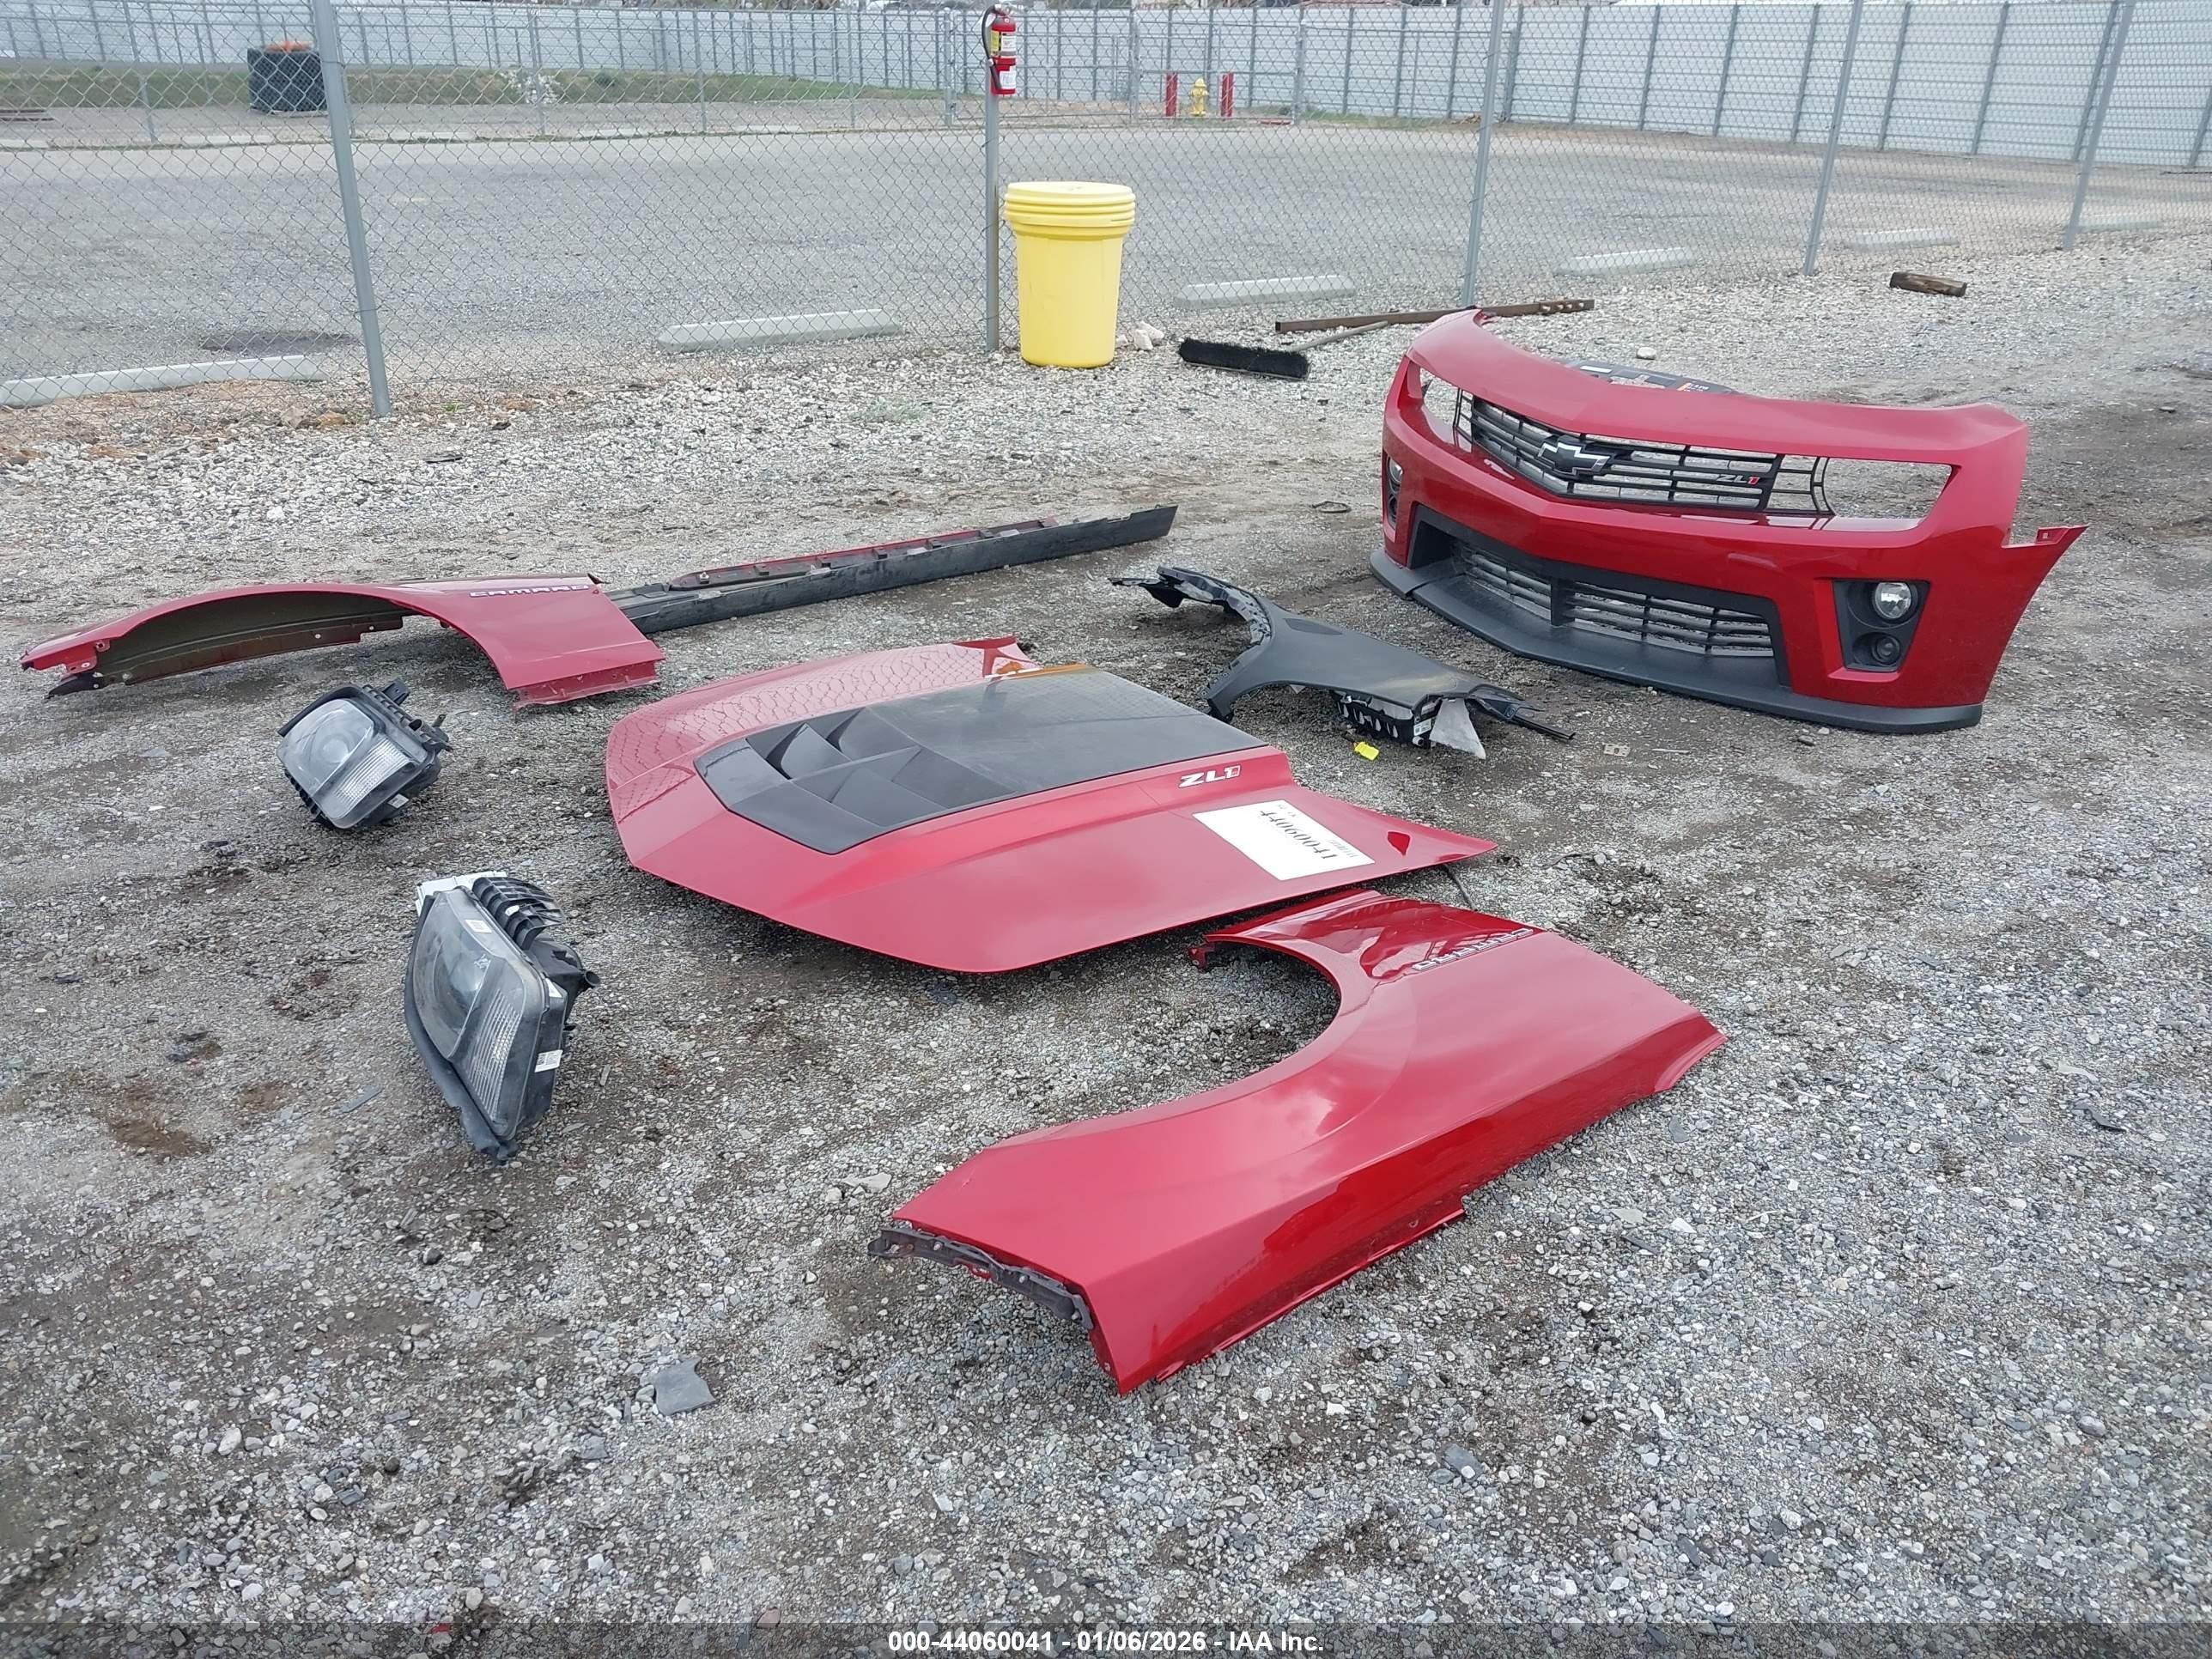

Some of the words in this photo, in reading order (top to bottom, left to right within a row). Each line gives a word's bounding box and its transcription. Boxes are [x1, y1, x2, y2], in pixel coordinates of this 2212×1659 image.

[1717, 474, 1760, 485] ZL1
[469, 584, 589, 598] CAMARO
[1178, 765, 1241, 787] ZL1
[1260, 811, 1338, 859] 44060041
